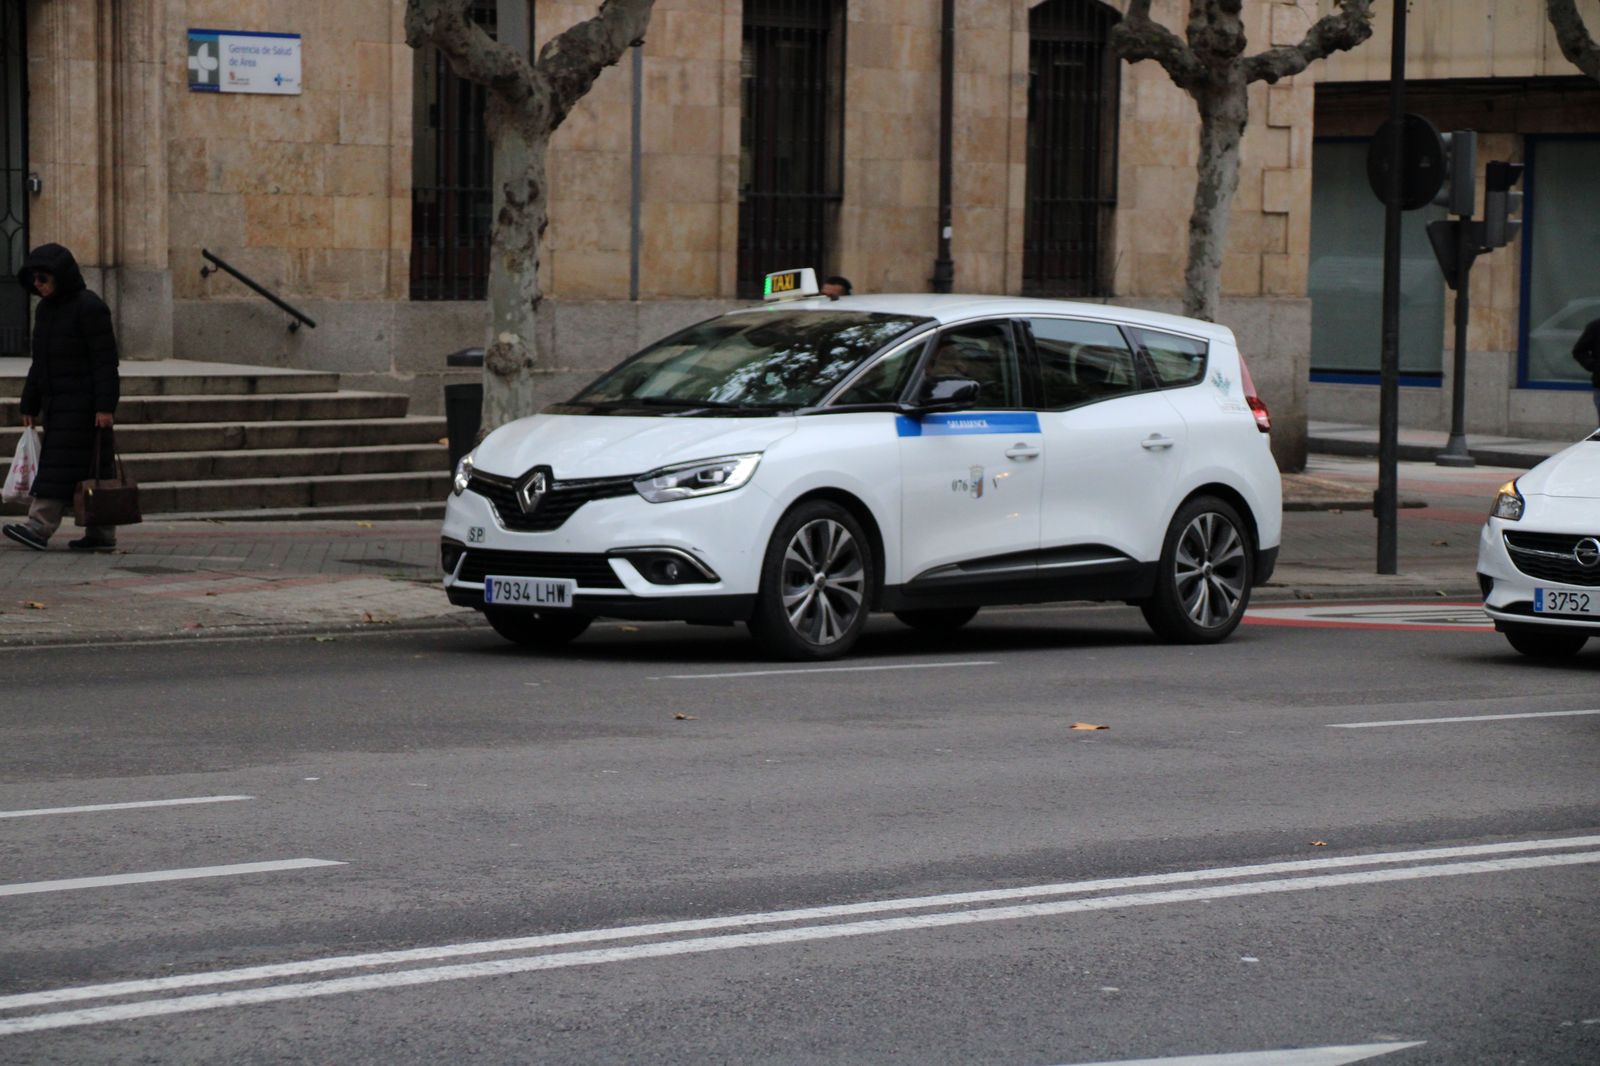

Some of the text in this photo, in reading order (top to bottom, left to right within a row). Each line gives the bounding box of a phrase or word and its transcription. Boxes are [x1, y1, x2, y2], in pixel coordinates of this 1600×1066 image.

[229, 44, 292, 56] Gerencia de Salud
[229, 57, 238, 66] de
[773, 274, 794, 291] TAXI
[494, 581, 530, 600] 7934
[536, 583, 565, 603] LHW
[1548, 592, 1590, 612] 3752
